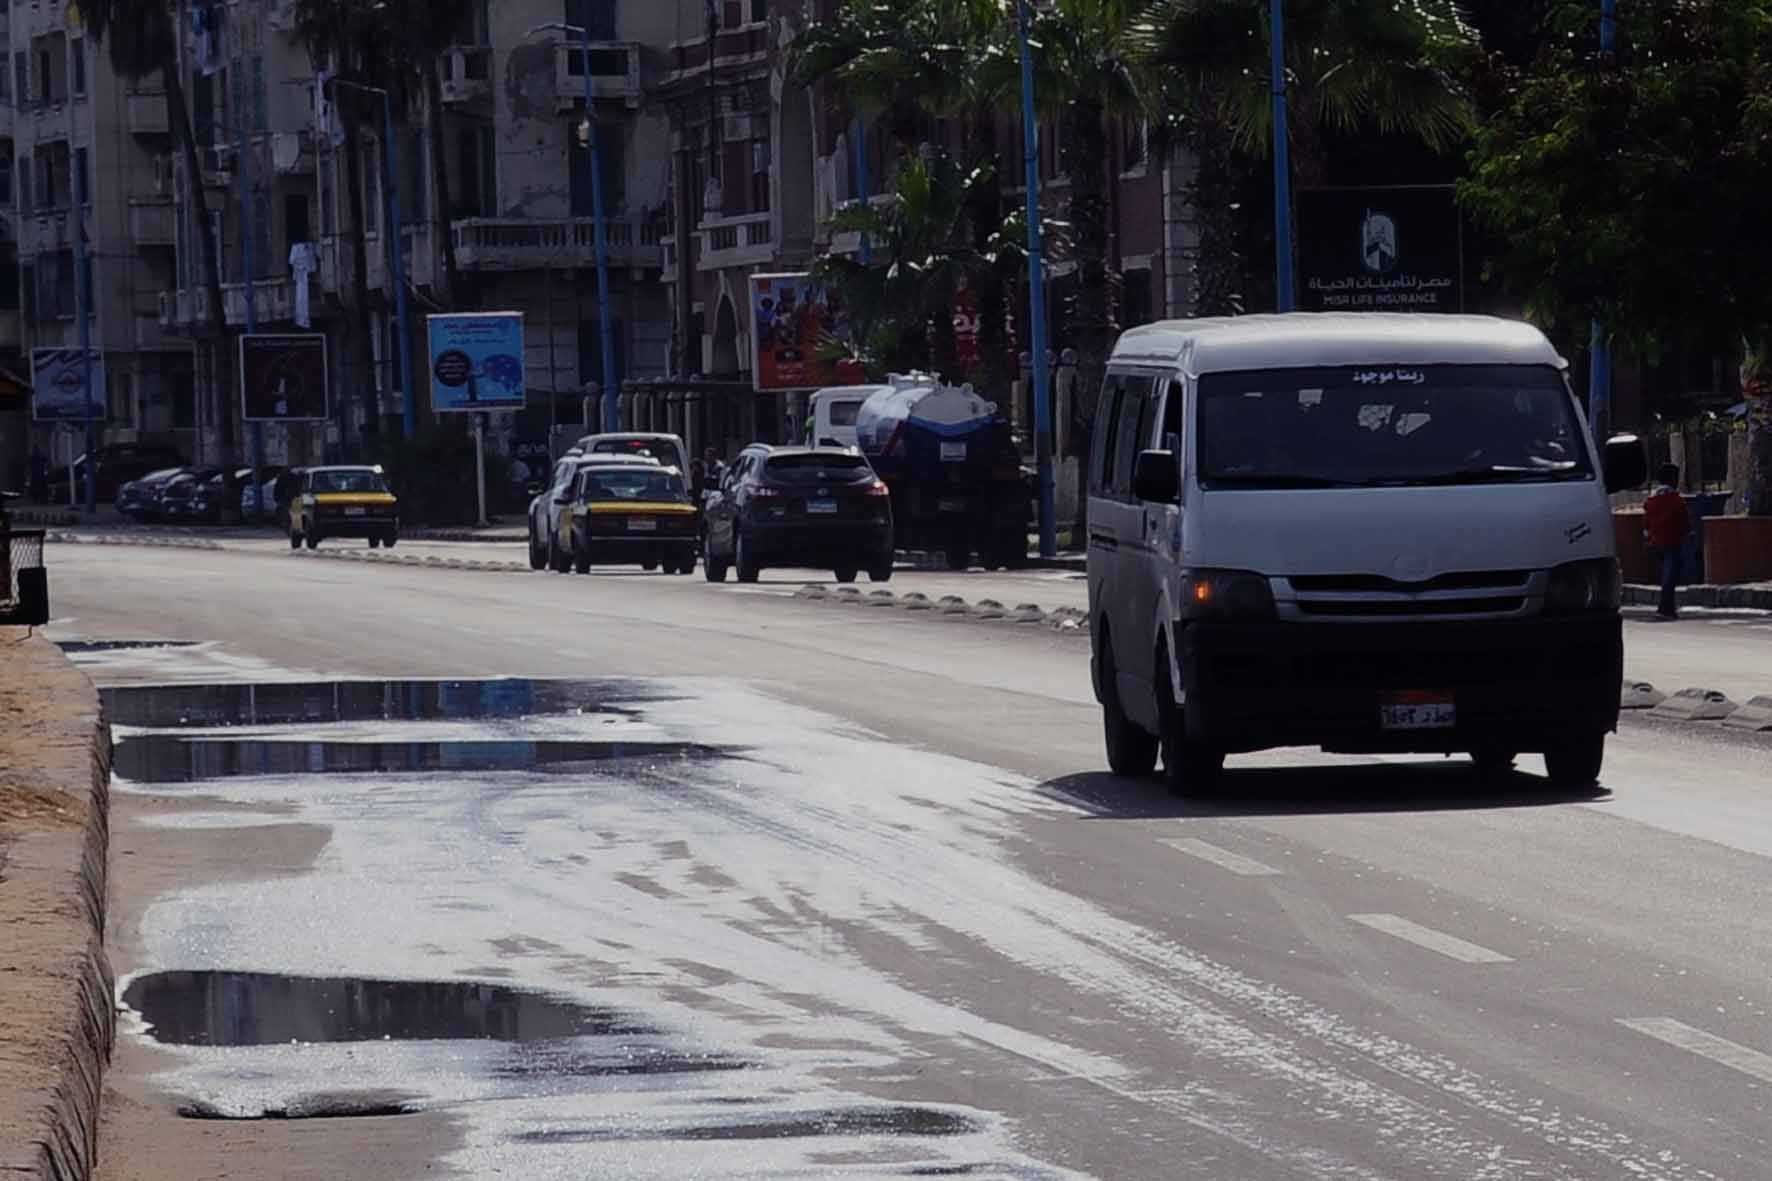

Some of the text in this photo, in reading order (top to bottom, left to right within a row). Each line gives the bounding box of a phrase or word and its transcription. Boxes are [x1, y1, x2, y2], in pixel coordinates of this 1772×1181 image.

[1417, 274, 1452, 291] مصر
[1322, 291, 1438, 305] MISR LIFE INSURANCE
